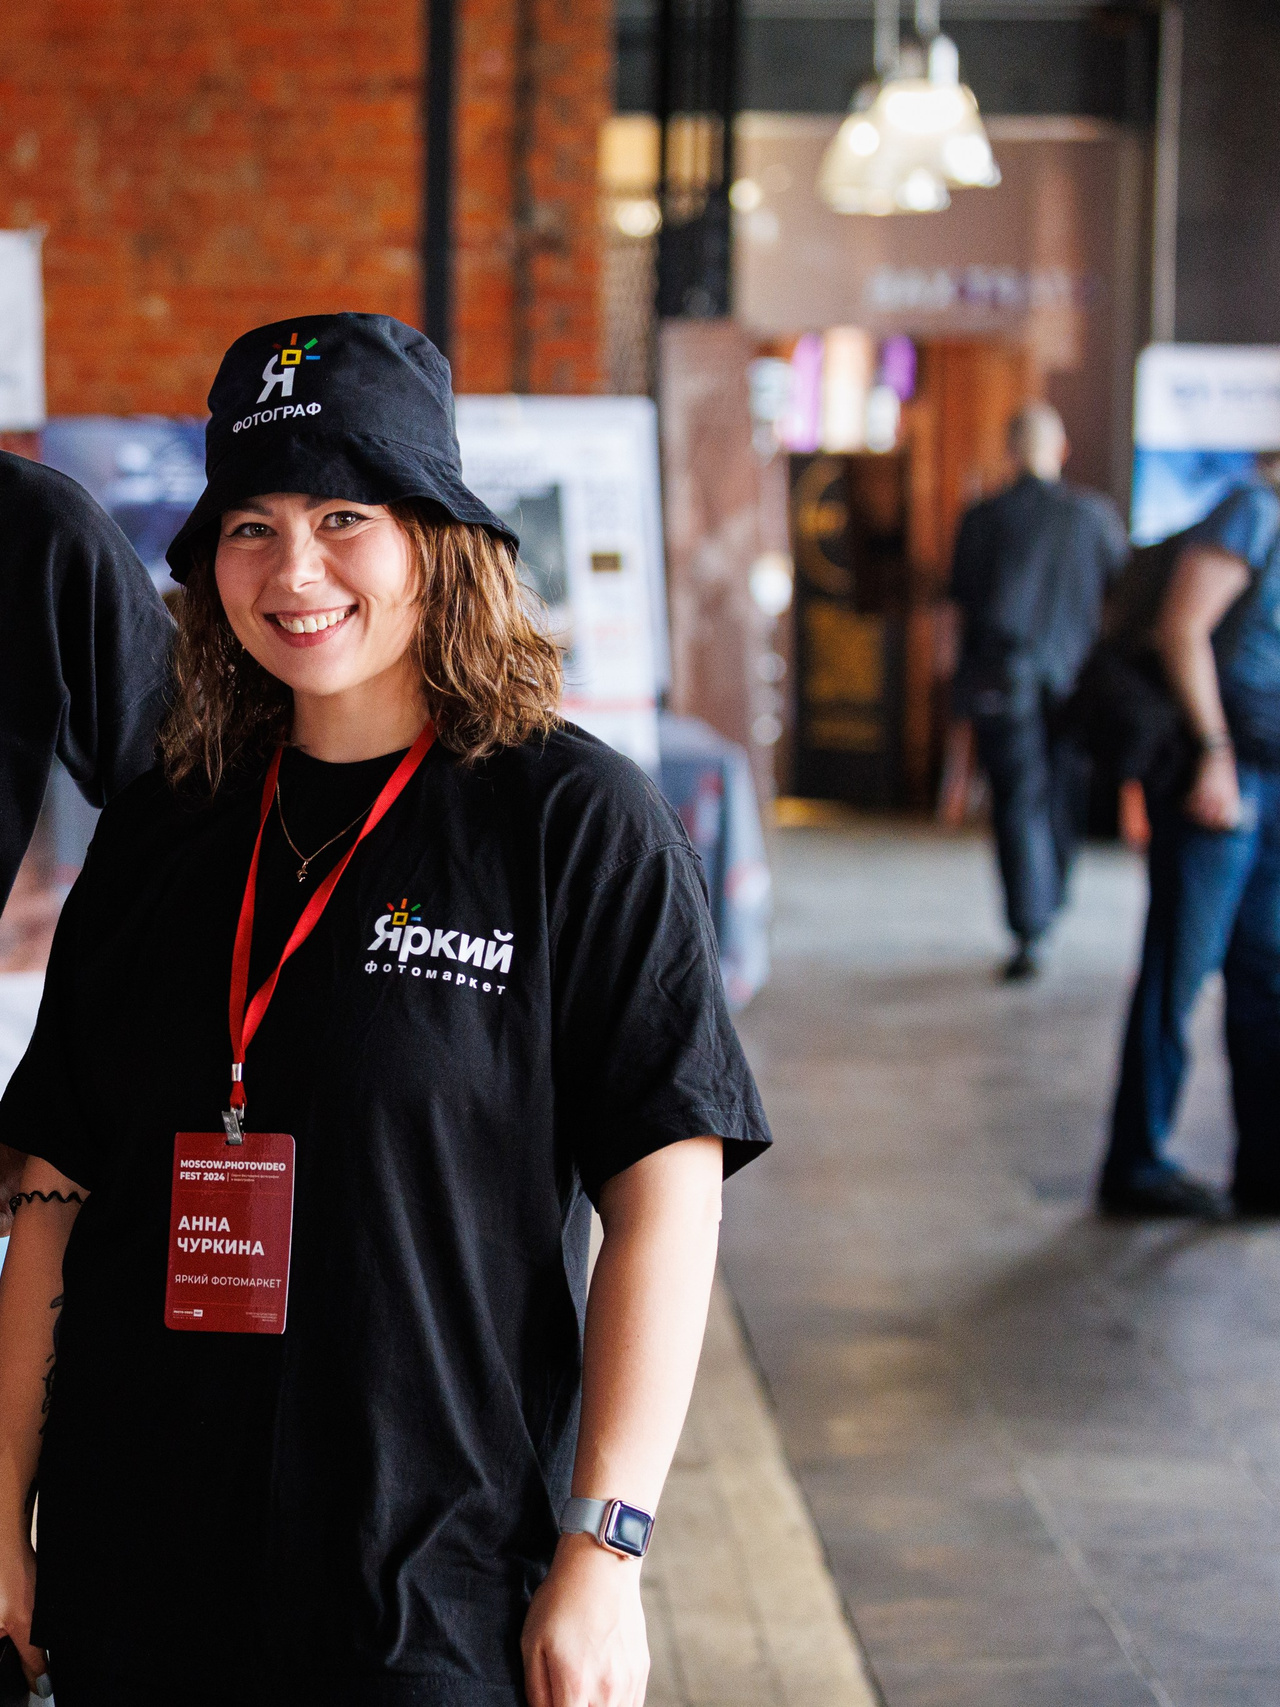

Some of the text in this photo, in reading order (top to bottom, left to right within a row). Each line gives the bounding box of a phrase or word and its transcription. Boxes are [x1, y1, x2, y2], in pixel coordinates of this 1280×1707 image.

[256, 354, 296, 404] Я
[232, 402, 322, 433] ФОТОГРАФ
[367, 914, 514, 974] Яркий
[364, 960, 506, 995] фотомаркет
[180, 1159, 286, 1172] MOSCOW.PHOTOVIDEO
[180, 1172, 202, 1180] FEST
[203, 1172, 225, 1182] 2024
[178, 1215, 231, 1232] АННА
[177, 1237, 265, 1256] ЧУРКИНА
[175, 1273, 282, 1289] ЯРКИЙ ФОТОМАРКЕТ
